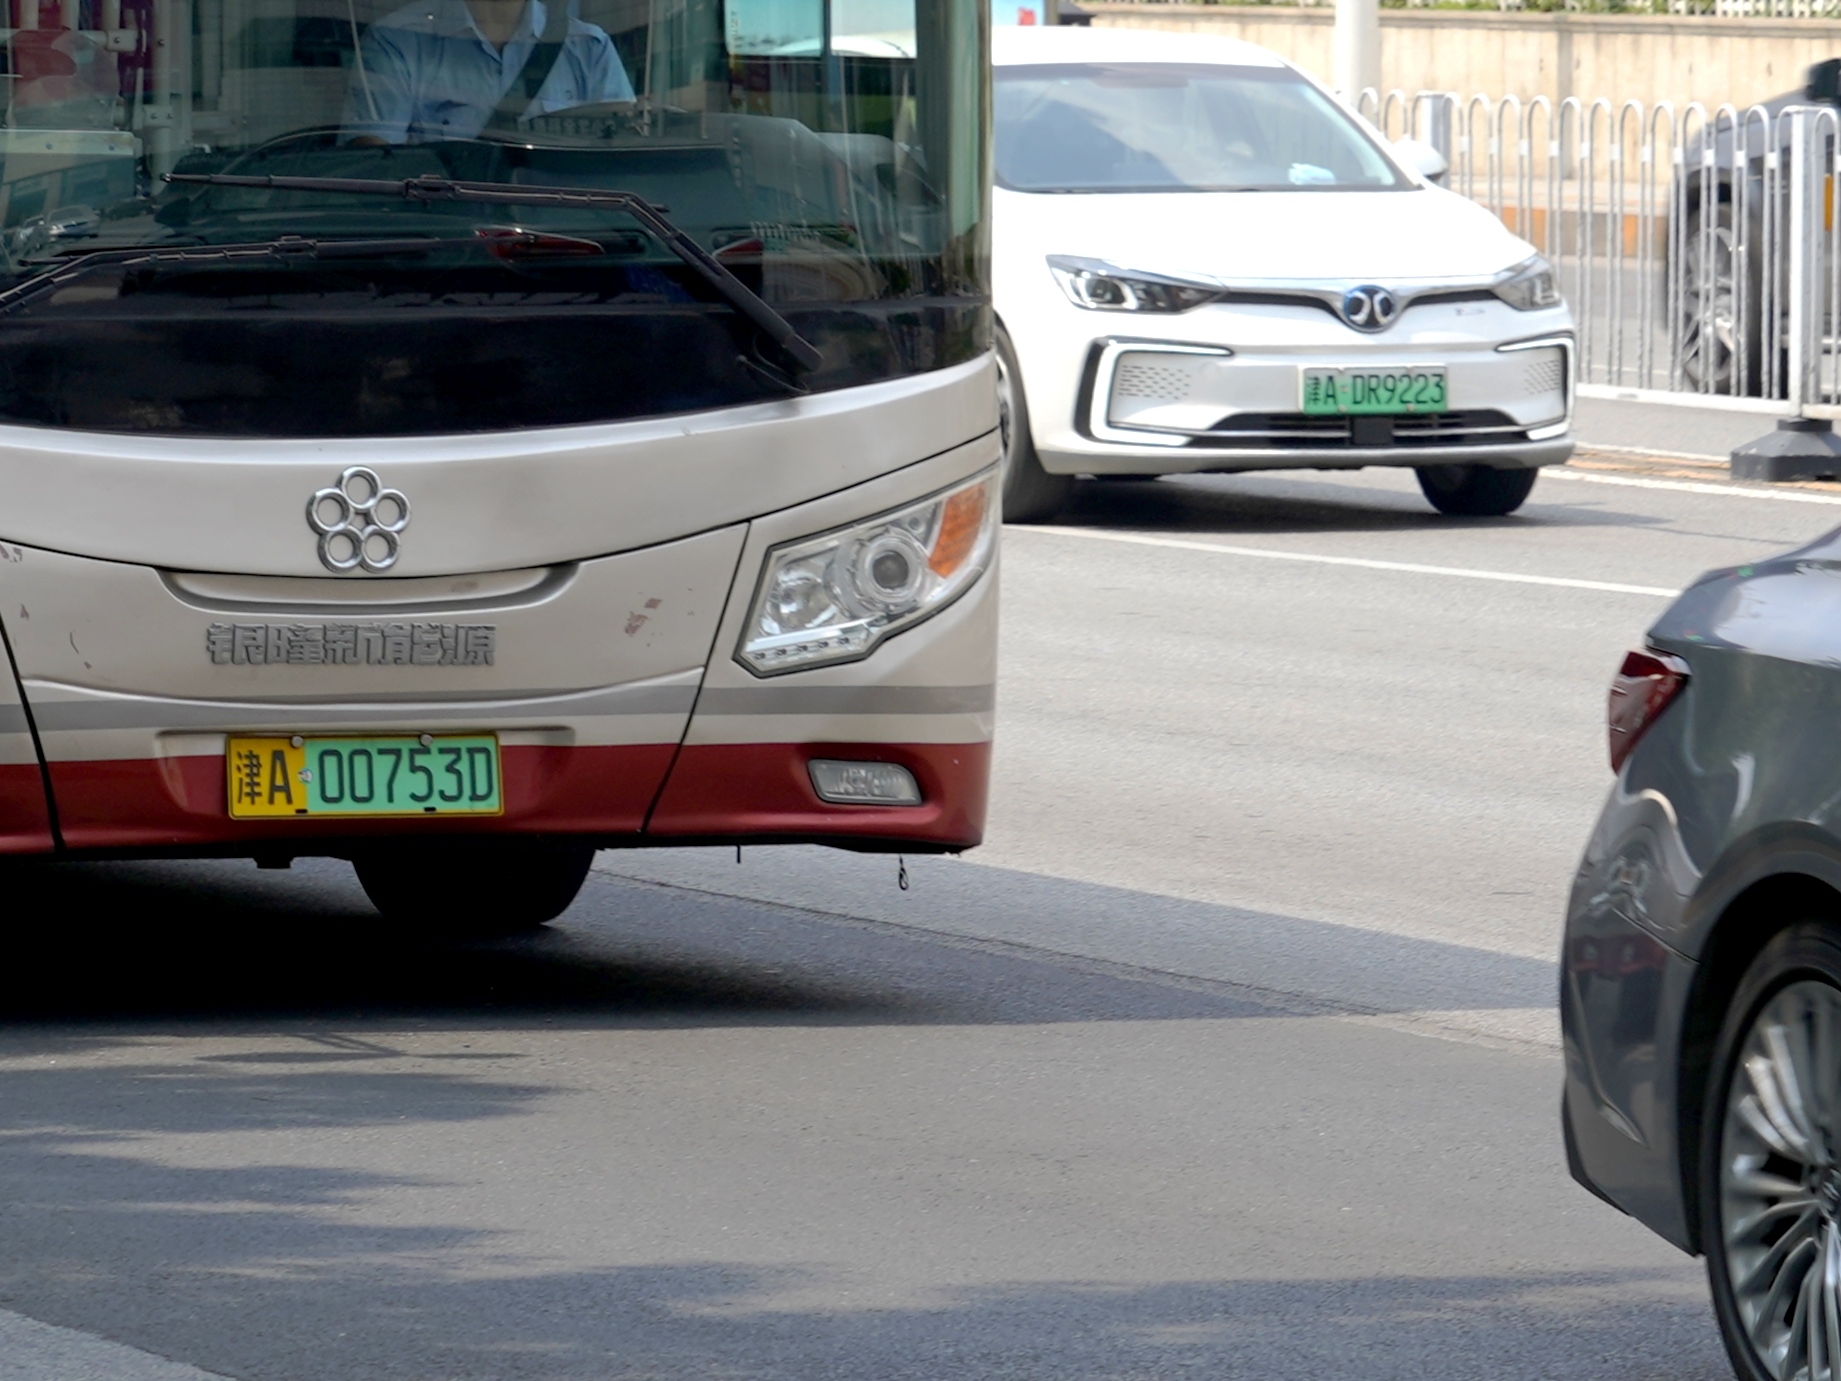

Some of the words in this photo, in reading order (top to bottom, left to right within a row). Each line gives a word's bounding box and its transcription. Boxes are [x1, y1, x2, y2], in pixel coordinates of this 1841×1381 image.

[206, 621, 497, 667] 银隆新能源
